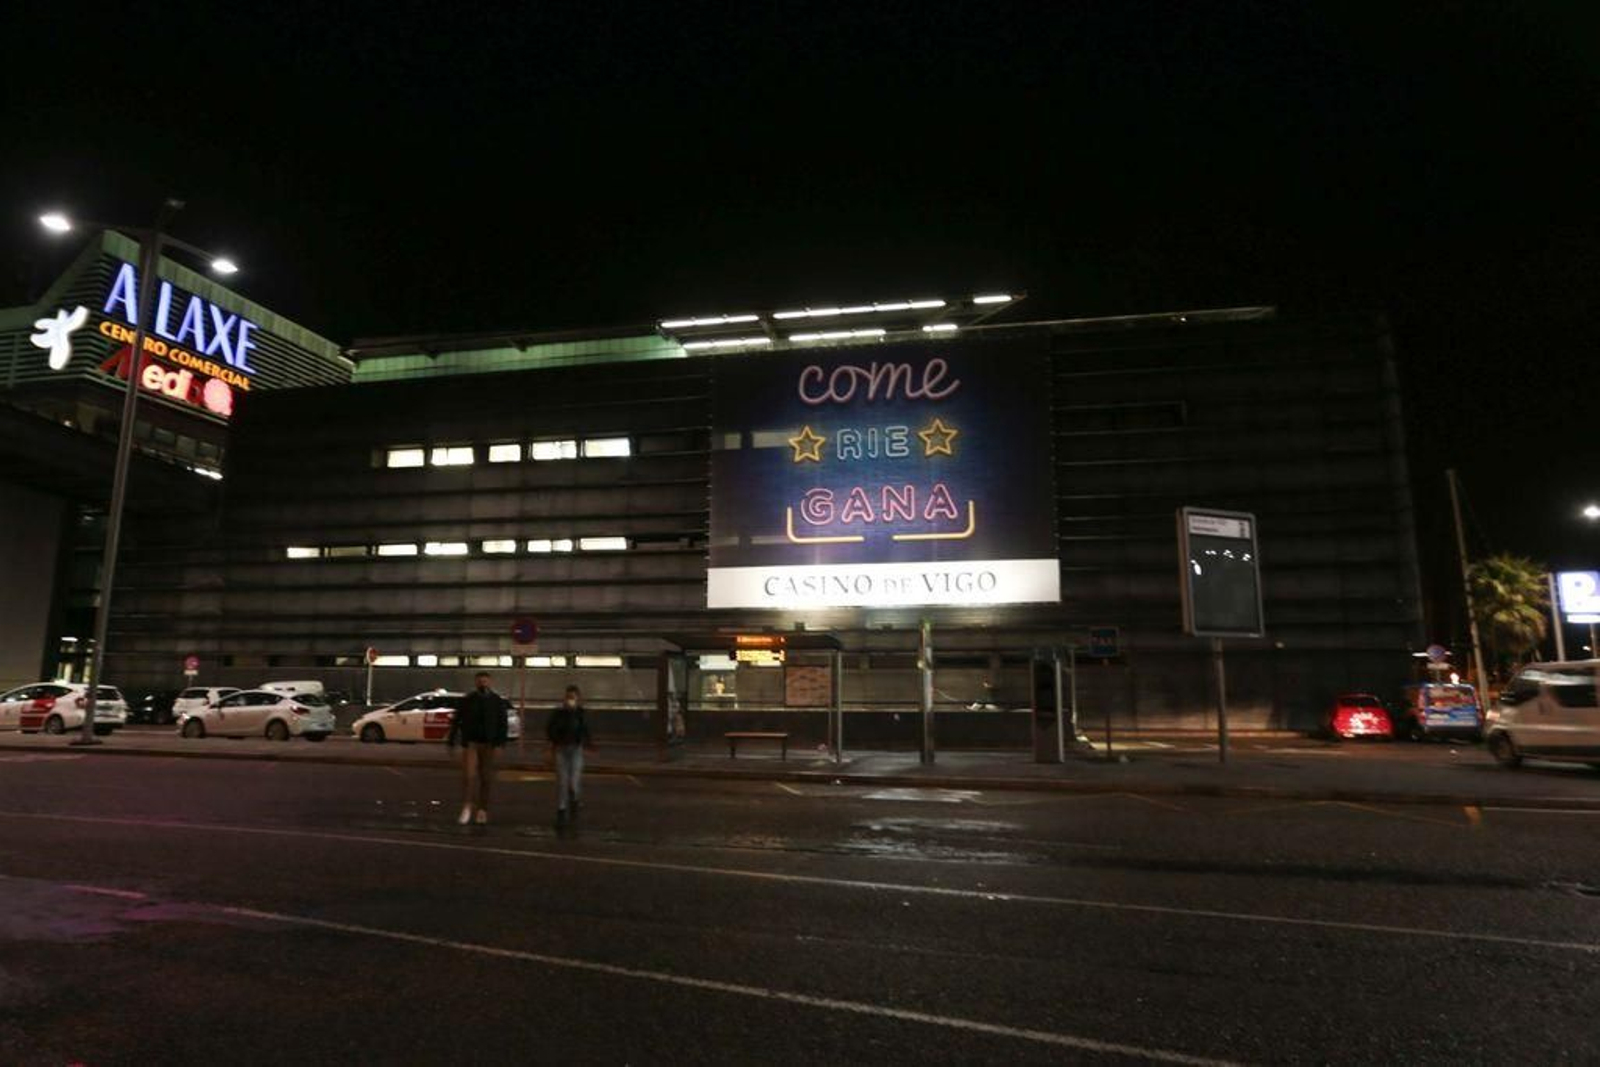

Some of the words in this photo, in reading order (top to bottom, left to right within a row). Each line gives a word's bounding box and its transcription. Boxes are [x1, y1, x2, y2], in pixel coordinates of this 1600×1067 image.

[104, 262, 138, 324] A
[155, 280, 258, 375] LAXE
[98, 321, 169, 357] CENRO
[168, 348, 251, 391] COMERCIAL
[836, 425, 910, 459] RIE
[800, 483, 958, 526] GANA
[763, 574, 873, 596] CASINO
[920, 570, 998, 593] VIGO
